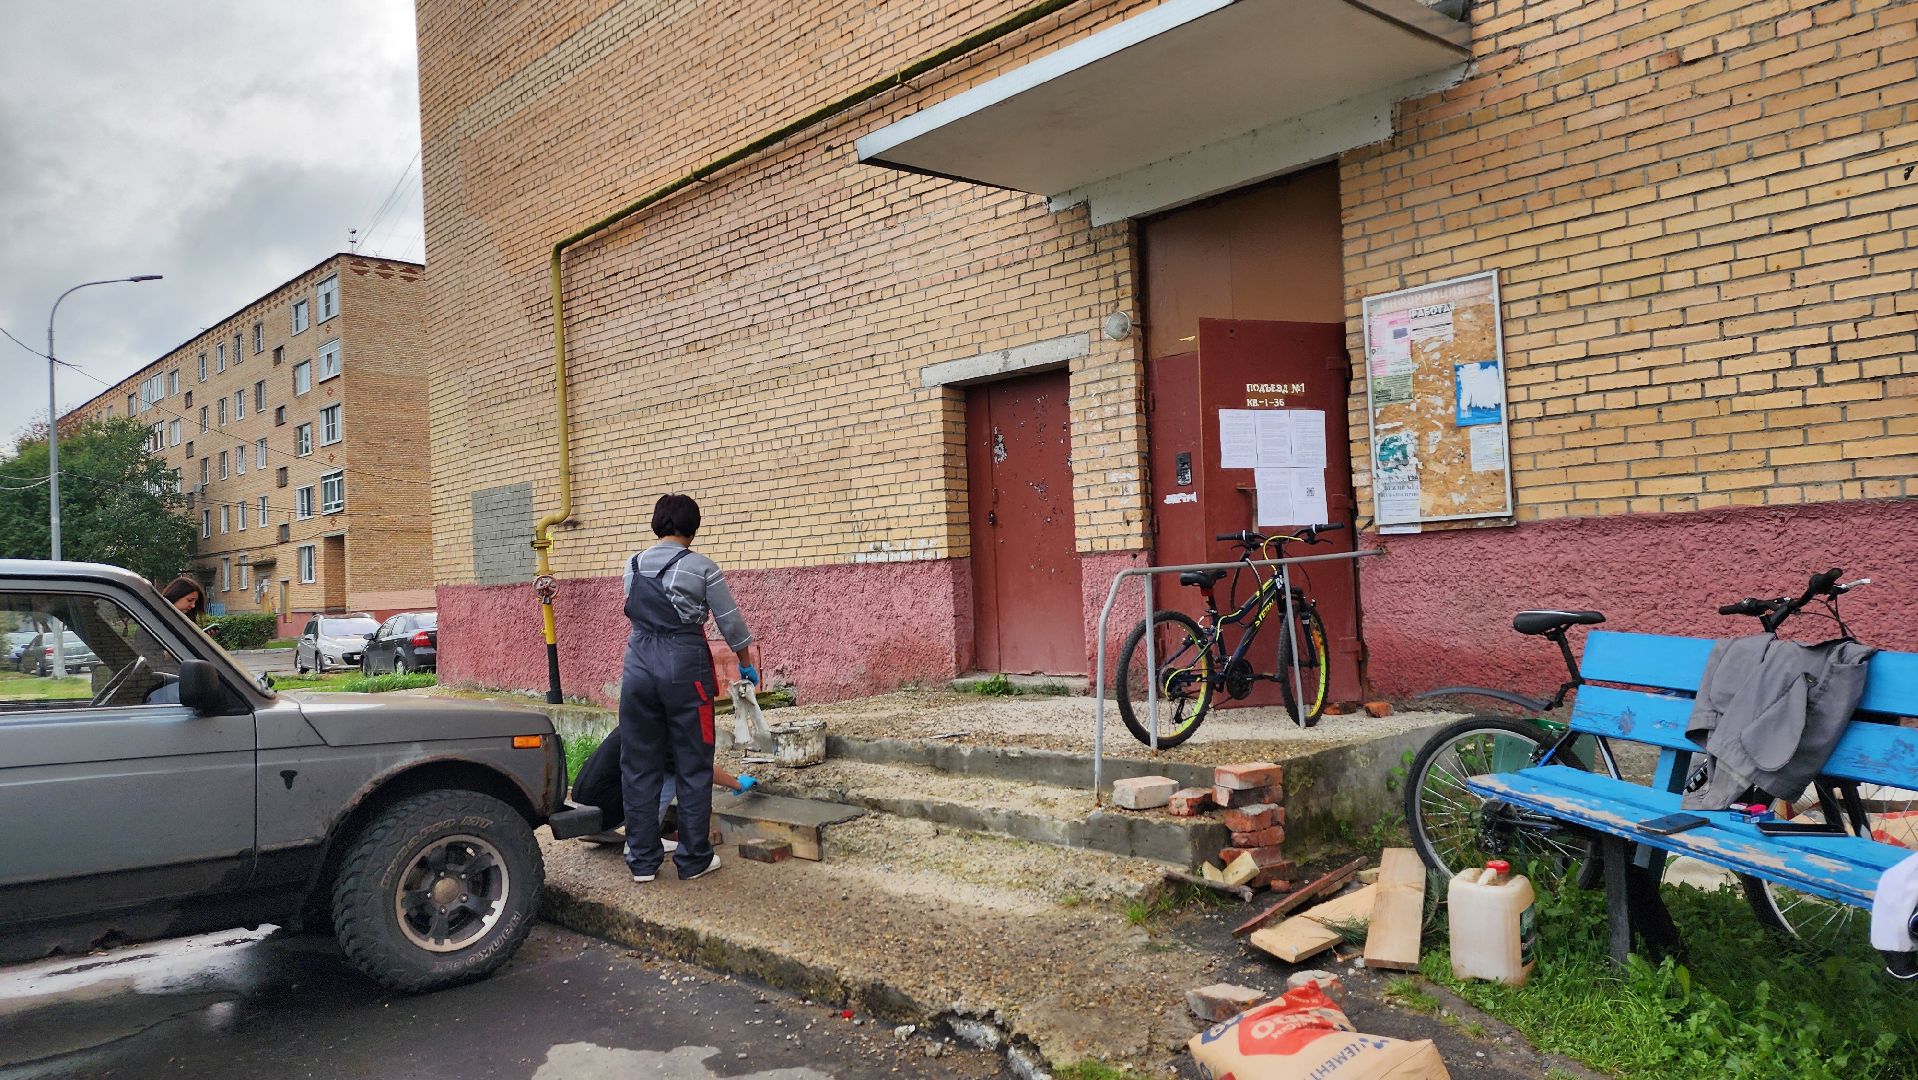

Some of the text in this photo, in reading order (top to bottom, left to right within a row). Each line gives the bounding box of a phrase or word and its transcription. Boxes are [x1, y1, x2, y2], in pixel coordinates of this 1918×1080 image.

[1381, 284, 1466, 311] ИНФОРМАЦИЯ
[1411, 303, 1452, 319] РАБОТА
[1246, 382, 1305, 394] ПОДЪЕЗД №1
